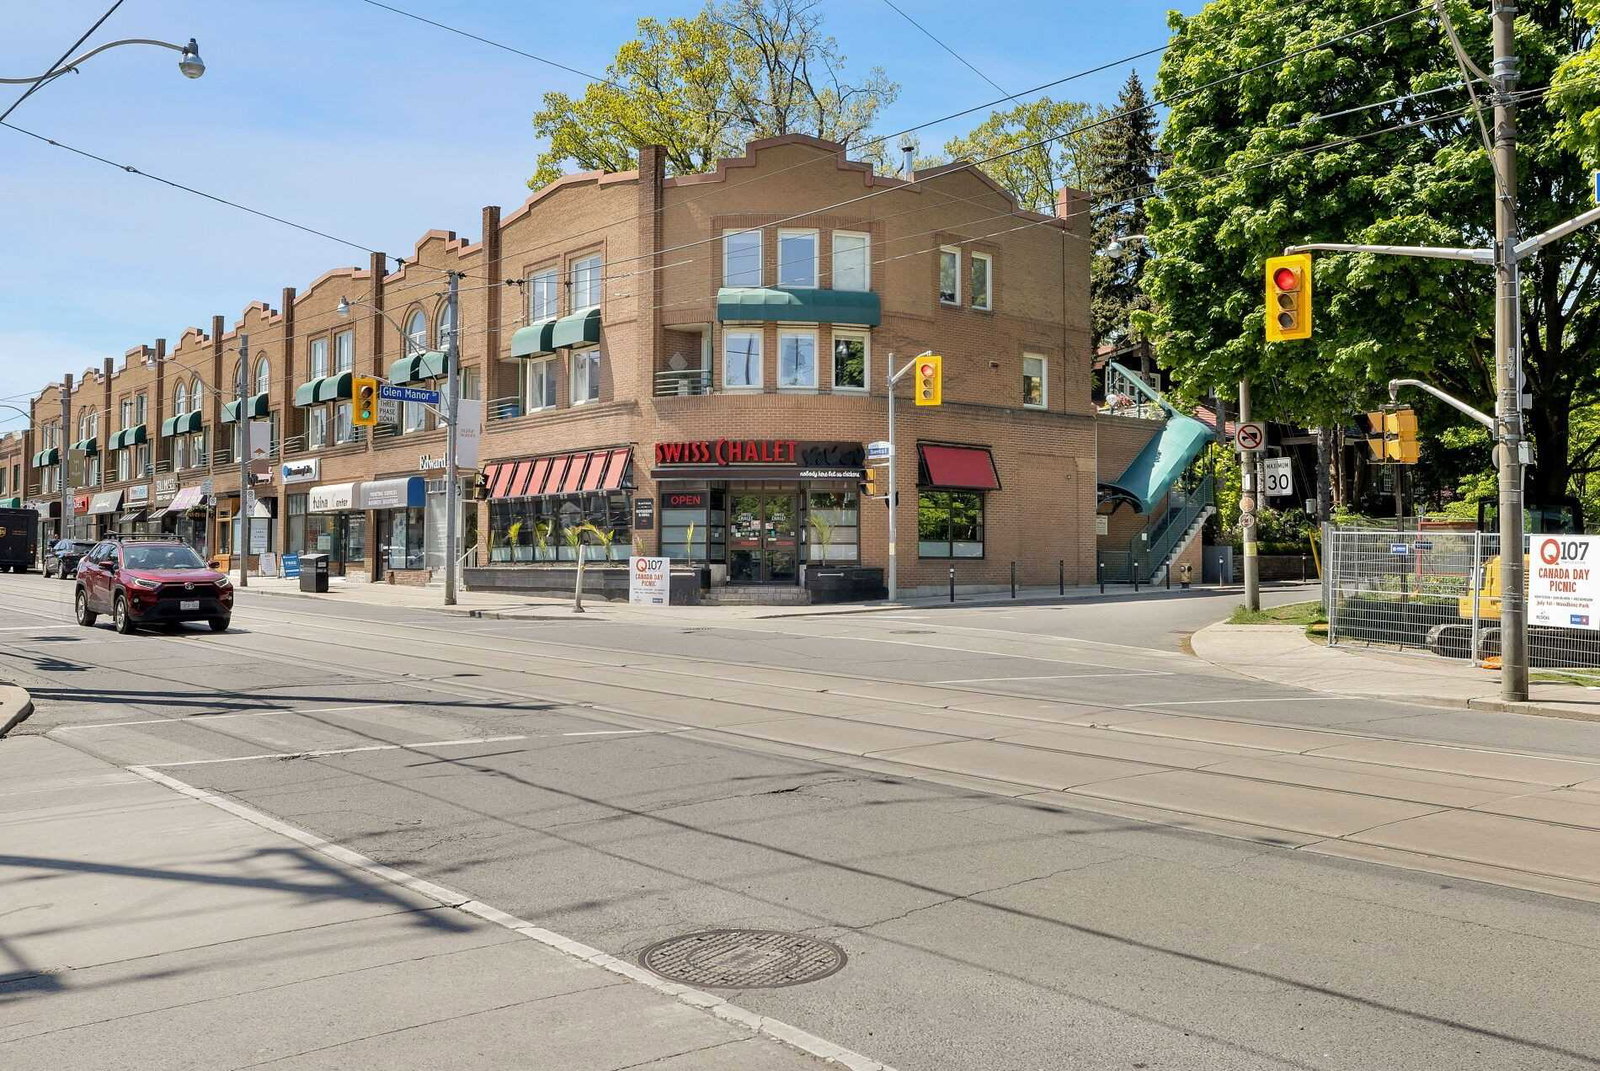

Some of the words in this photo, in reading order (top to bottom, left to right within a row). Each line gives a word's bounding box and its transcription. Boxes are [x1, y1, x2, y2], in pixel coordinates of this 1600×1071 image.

[382, 386, 402, 398] Glen
[404, 389, 430, 400] Manor
[655, 442, 711, 464] SWISS
[715, 437, 799, 466] CHALET
[420, 453, 448, 471] Edward
[1267, 474, 1289, 491] 30
[671, 495, 701, 505] OPEN
[1540, 538, 1590, 565] Q107
[636, 558, 663, 573] Q107
[1538, 567, 1570, 580] CANADA
[1572, 568, 1590, 580] DAY
[1549, 580, 1577, 592] PICNIC
